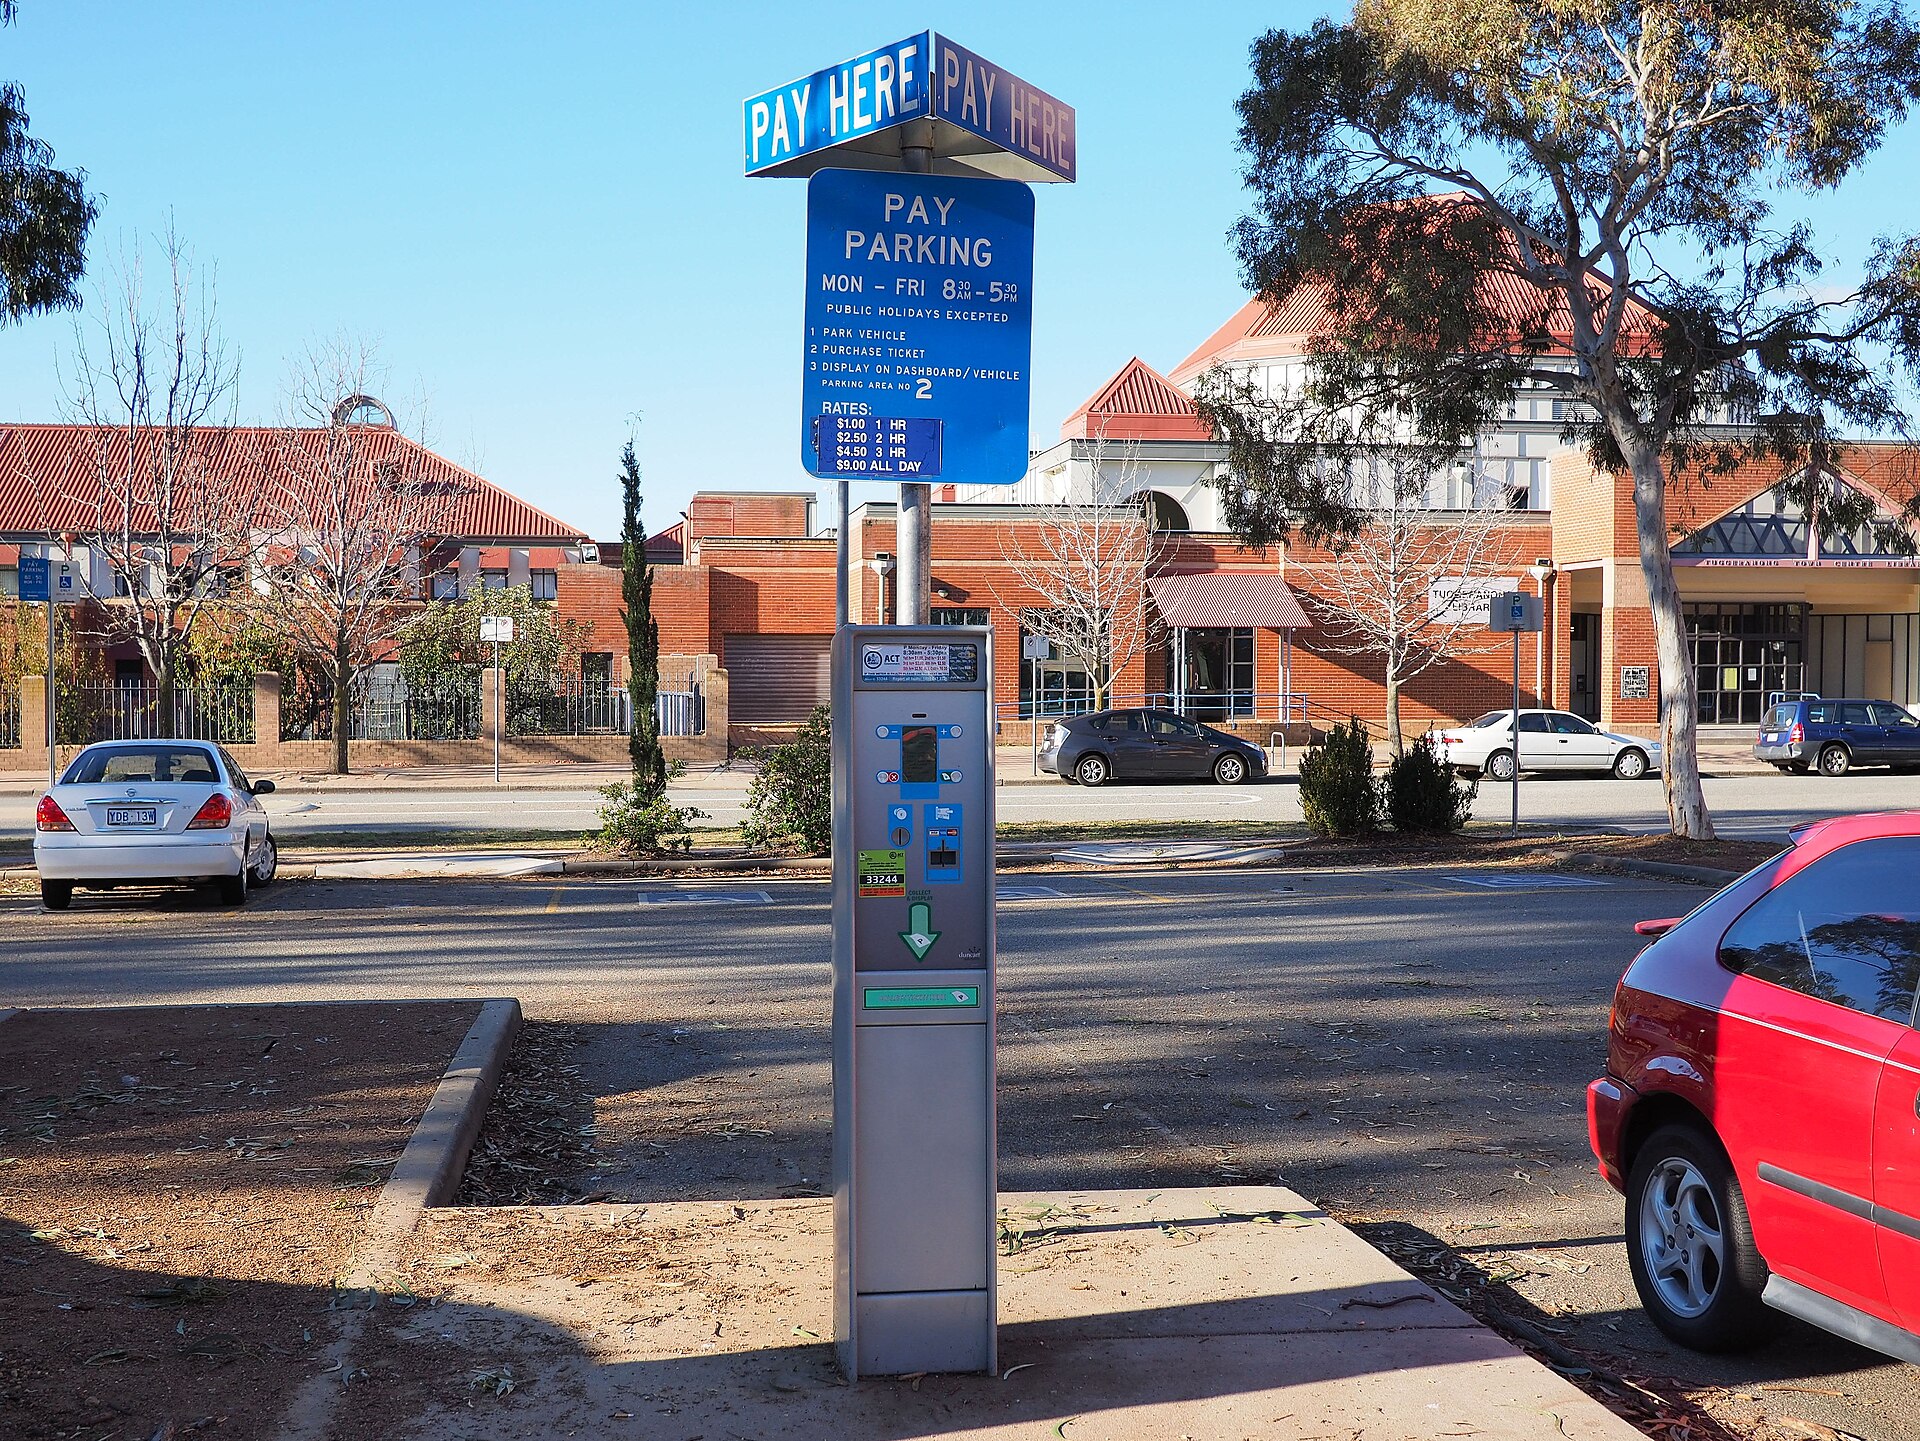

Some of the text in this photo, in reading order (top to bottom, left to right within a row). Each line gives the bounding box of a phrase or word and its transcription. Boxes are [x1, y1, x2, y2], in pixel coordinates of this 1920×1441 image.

[752, 45, 918, 163] PAY HERE
[943, 47, 1070, 170] PAY HERE
[885, 193, 955, 226] PAY
[845, 230, 992, 268] PARKING
[822, 273, 863, 293] MON
[896, 278, 926, 297] FRI
[826, 304, 1009, 323] PUBLIC HOLIDAYS EXCEPTED
[810, 327, 906, 341] 1 PARK VEHICLE
[810, 345, 926, 359] 2 PURCHASE TICKET
[810, 362, 817, 371] 3
[822, 362, 870, 374] DISPLAY
[875, 364, 890, 374] ON
[821, 378, 933, 400] PARKING AREA NO 2
[822, 401, 872, 416] RATES:
[836, 418, 907, 430] $1.00 1 HR
[836, 432, 906, 444] $2.50 2 HR
[836, 446, 906, 457] $4.50 3 HR
[836, 459, 922, 472] $9.00 ALL DAY
[61, 564, 70, 575] P
[1512, 595, 1521, 605] P
[884, 654, 900, 662] ACT
[866, 874, 898, 884] 33244
